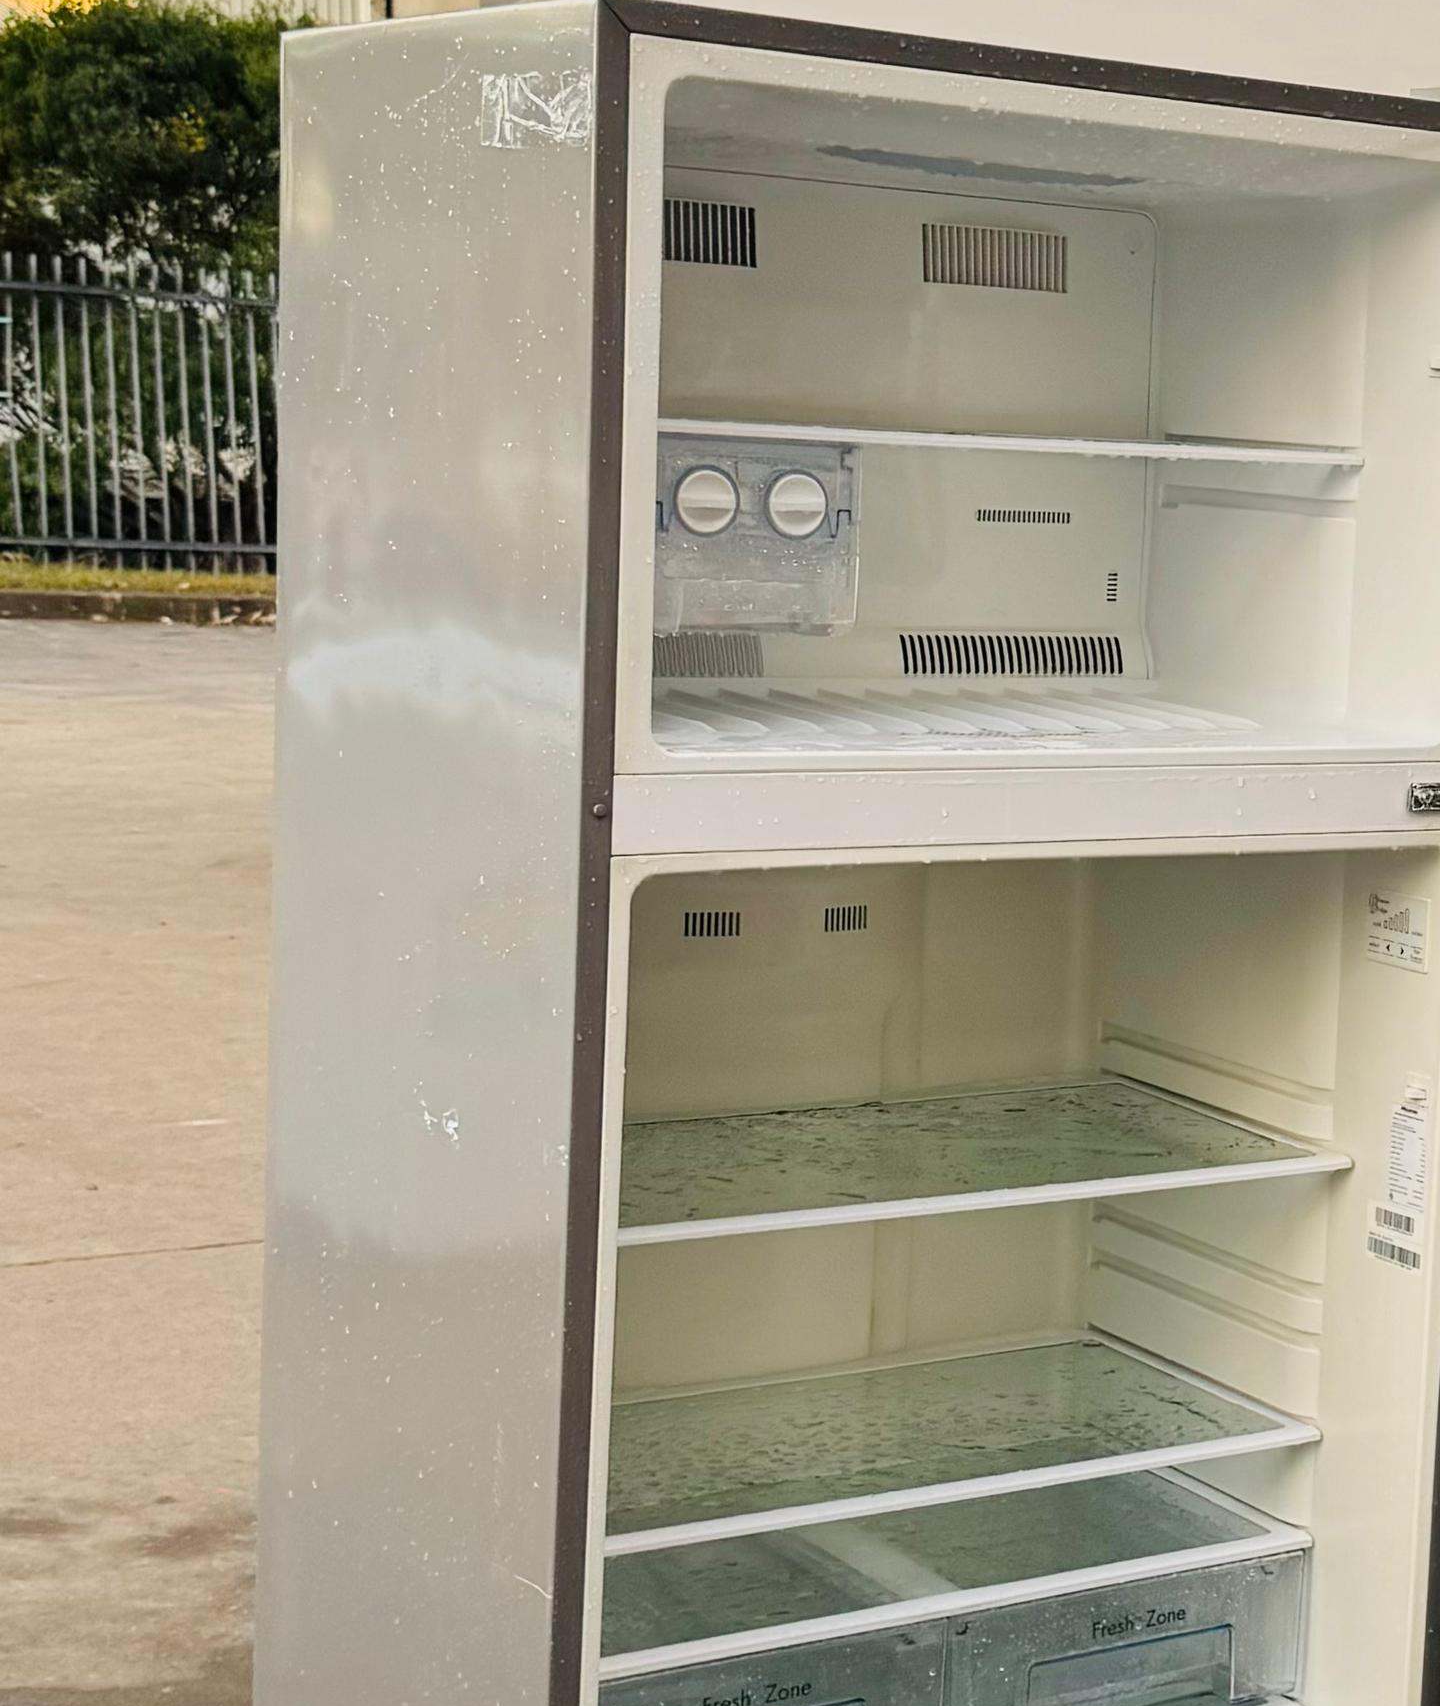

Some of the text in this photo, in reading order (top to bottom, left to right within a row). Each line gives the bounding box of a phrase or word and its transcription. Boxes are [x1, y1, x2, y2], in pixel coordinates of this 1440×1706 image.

[1092, 1608, 1187, 1639] Fresh Zone
[764, 1682, 812, 1704] Zone
